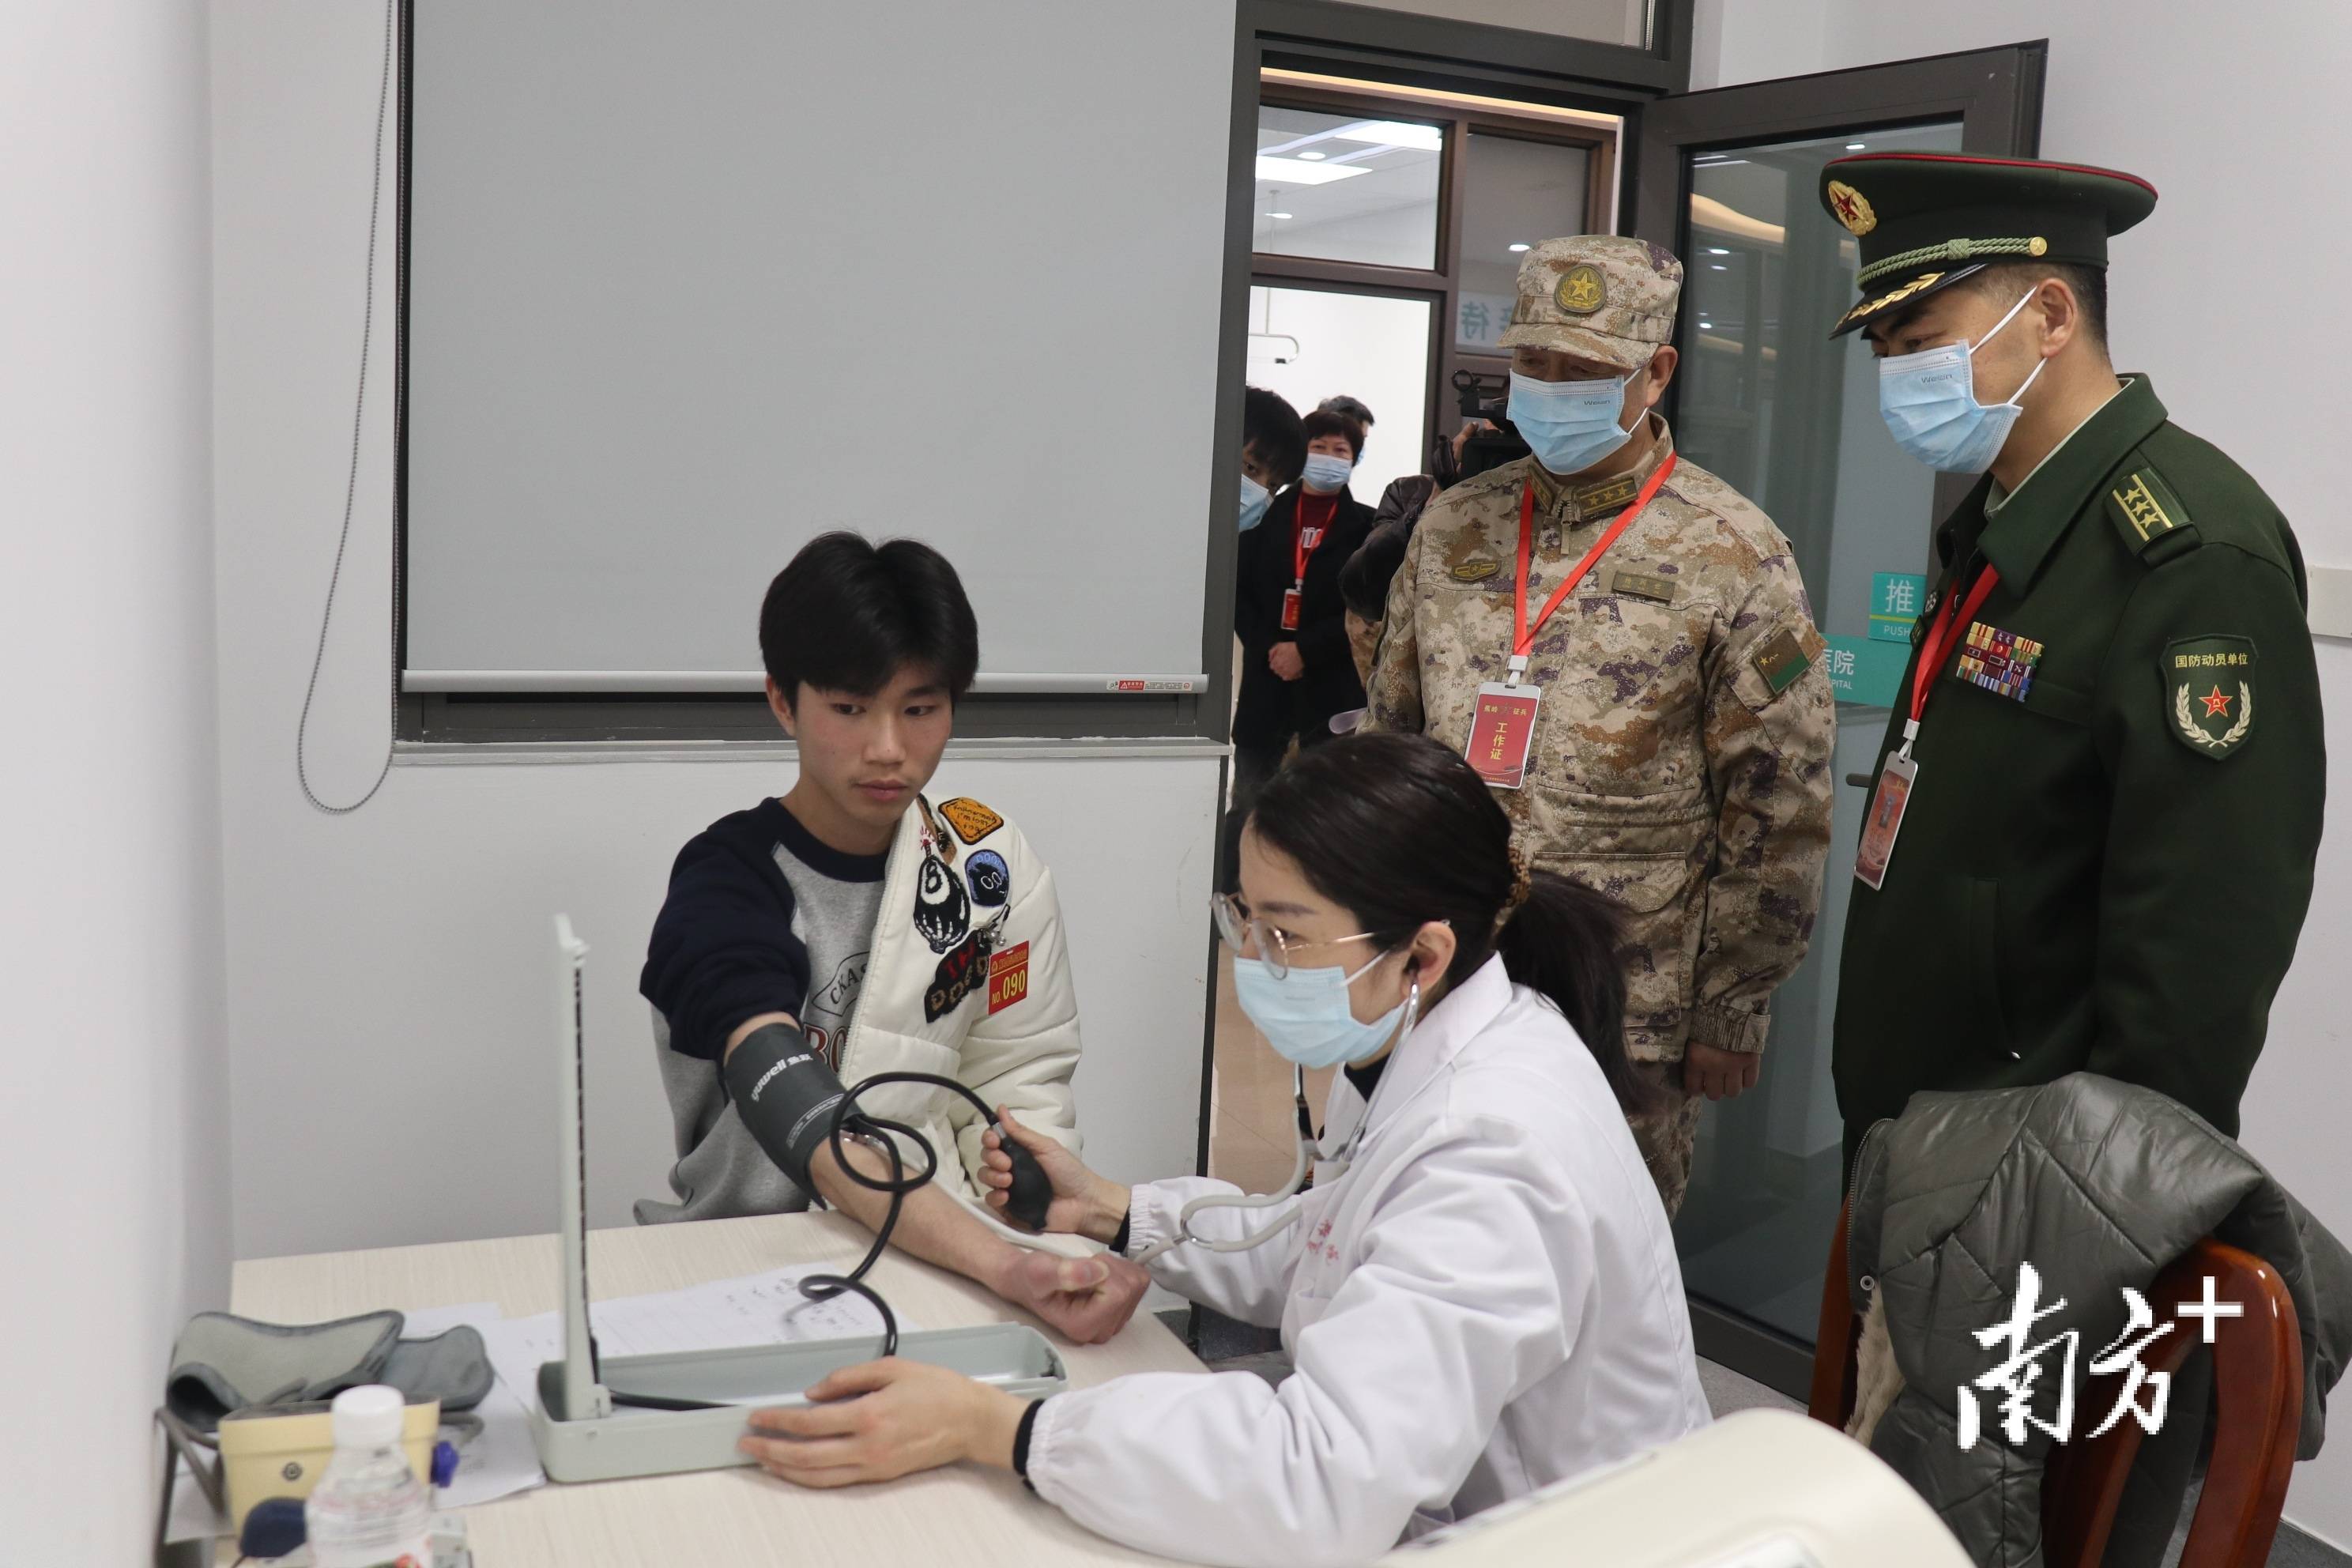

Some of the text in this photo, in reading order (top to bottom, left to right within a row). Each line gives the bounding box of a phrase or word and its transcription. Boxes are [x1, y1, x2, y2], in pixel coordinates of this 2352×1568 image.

[1885, 578, 1915, 613] 推
[1883, 625, 1911, 637] PUSH
[2175, 653, 2248, 669] 国防动员单位
[1832, 679, 1853, 690] PITAL
[1490, 722, 1508, 760] 工作证
[1002, 969, 1026, 1000] 090
[751, 1058, 787, 1102] yuwell
